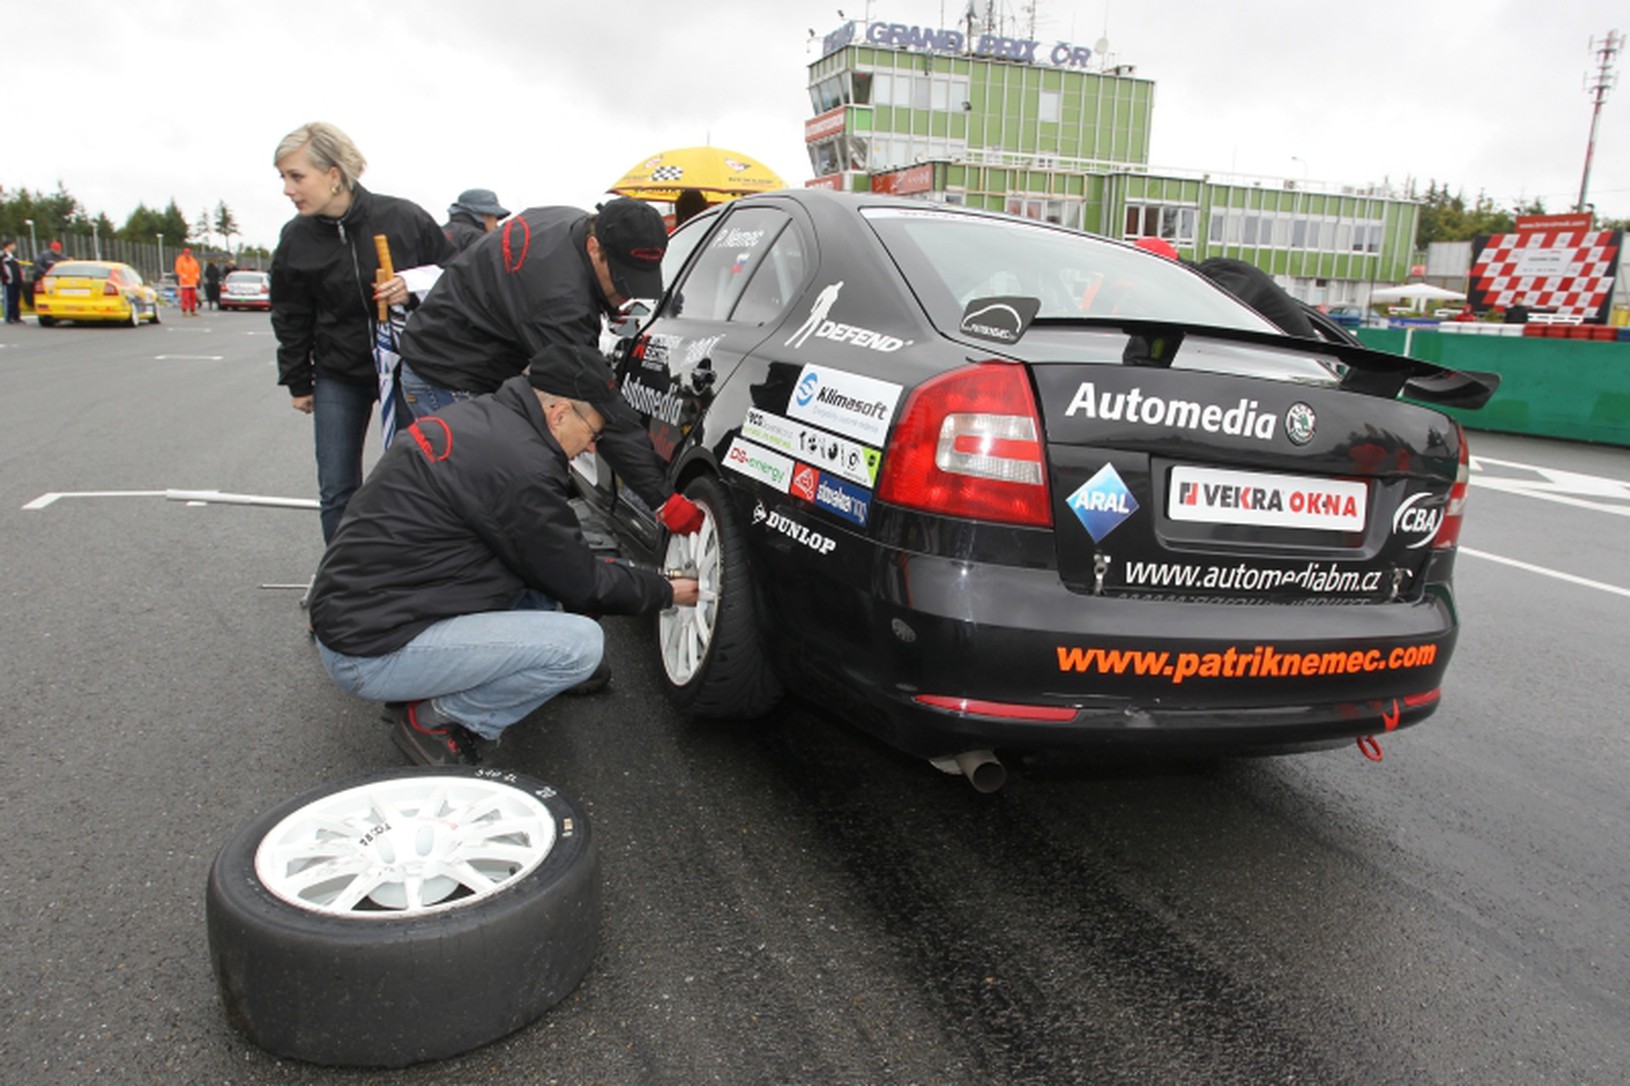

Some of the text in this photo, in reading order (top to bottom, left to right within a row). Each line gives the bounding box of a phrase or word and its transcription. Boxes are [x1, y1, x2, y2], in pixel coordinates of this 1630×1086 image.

[866, 21, 964, 51] GRAND
[976, 33, 1040, 63] PRIX
[1050, 41, 1091, 67] ČR
[815, 320, 903, 351] DEFEND
[817, 385, 888, 421] Klimasoft
[1065, 382, 1278, 440] Automedia
[1075, 489, 1131, 513] ARAL
[1203, 483, 1358, 518] VEKRA OKNA
[766, 510, 837, 555] DUNLOP
[1402, 507, 1437, 533] CBA
[1125, 561, 1382, 592] www.automediabm.cz
[1056, 643, 1437, 684] www.patriknemec.com
